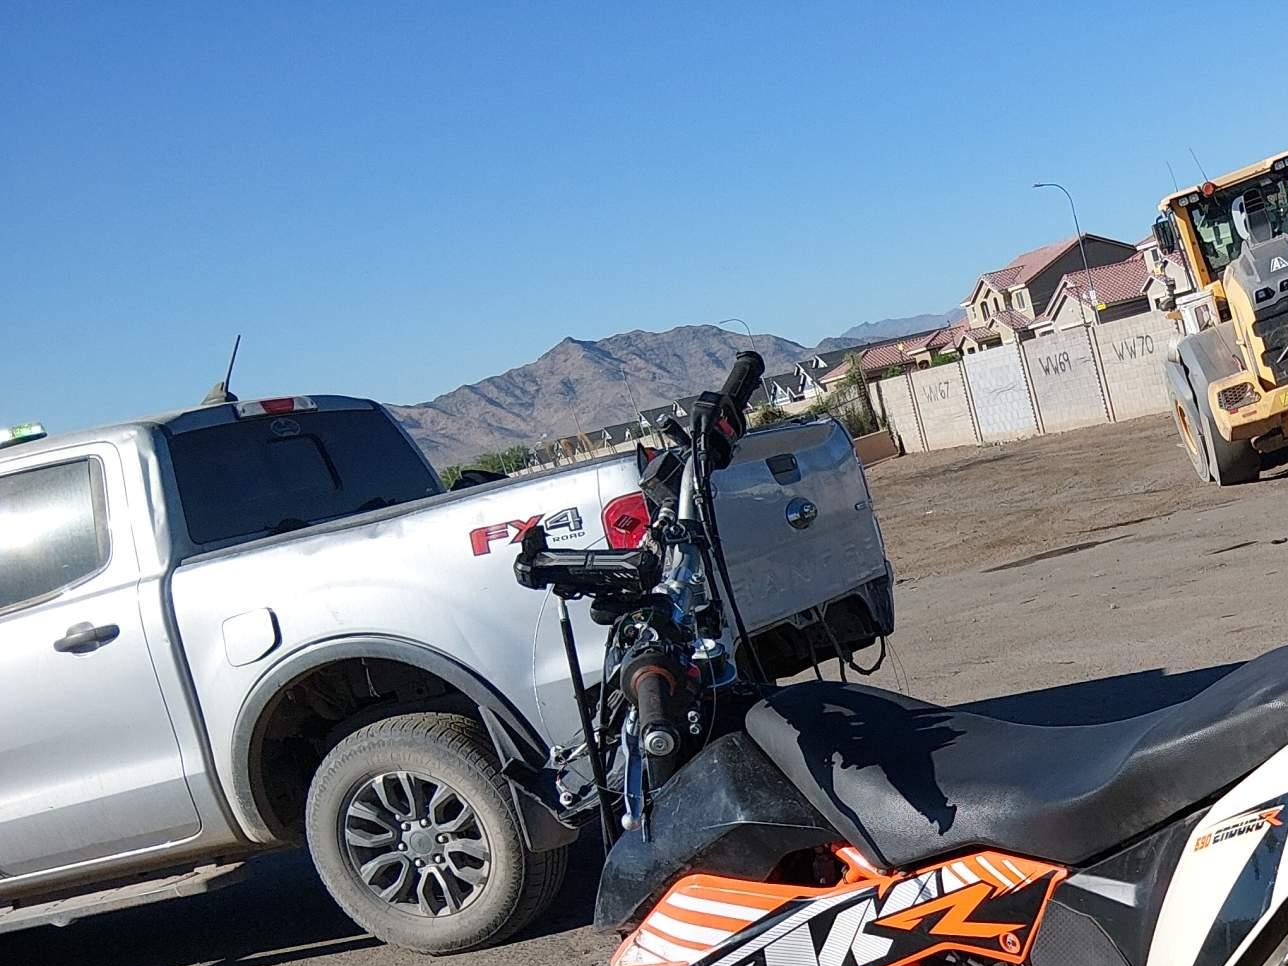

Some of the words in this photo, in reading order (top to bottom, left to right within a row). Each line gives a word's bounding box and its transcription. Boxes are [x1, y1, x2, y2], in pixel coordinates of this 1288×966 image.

[1111, 335, 1154, 361] WW70
[1038, 351, 1072, 377] WW69
[470, 507, 583, 556] FX4
[552, 531, 586, 543] ROAD
